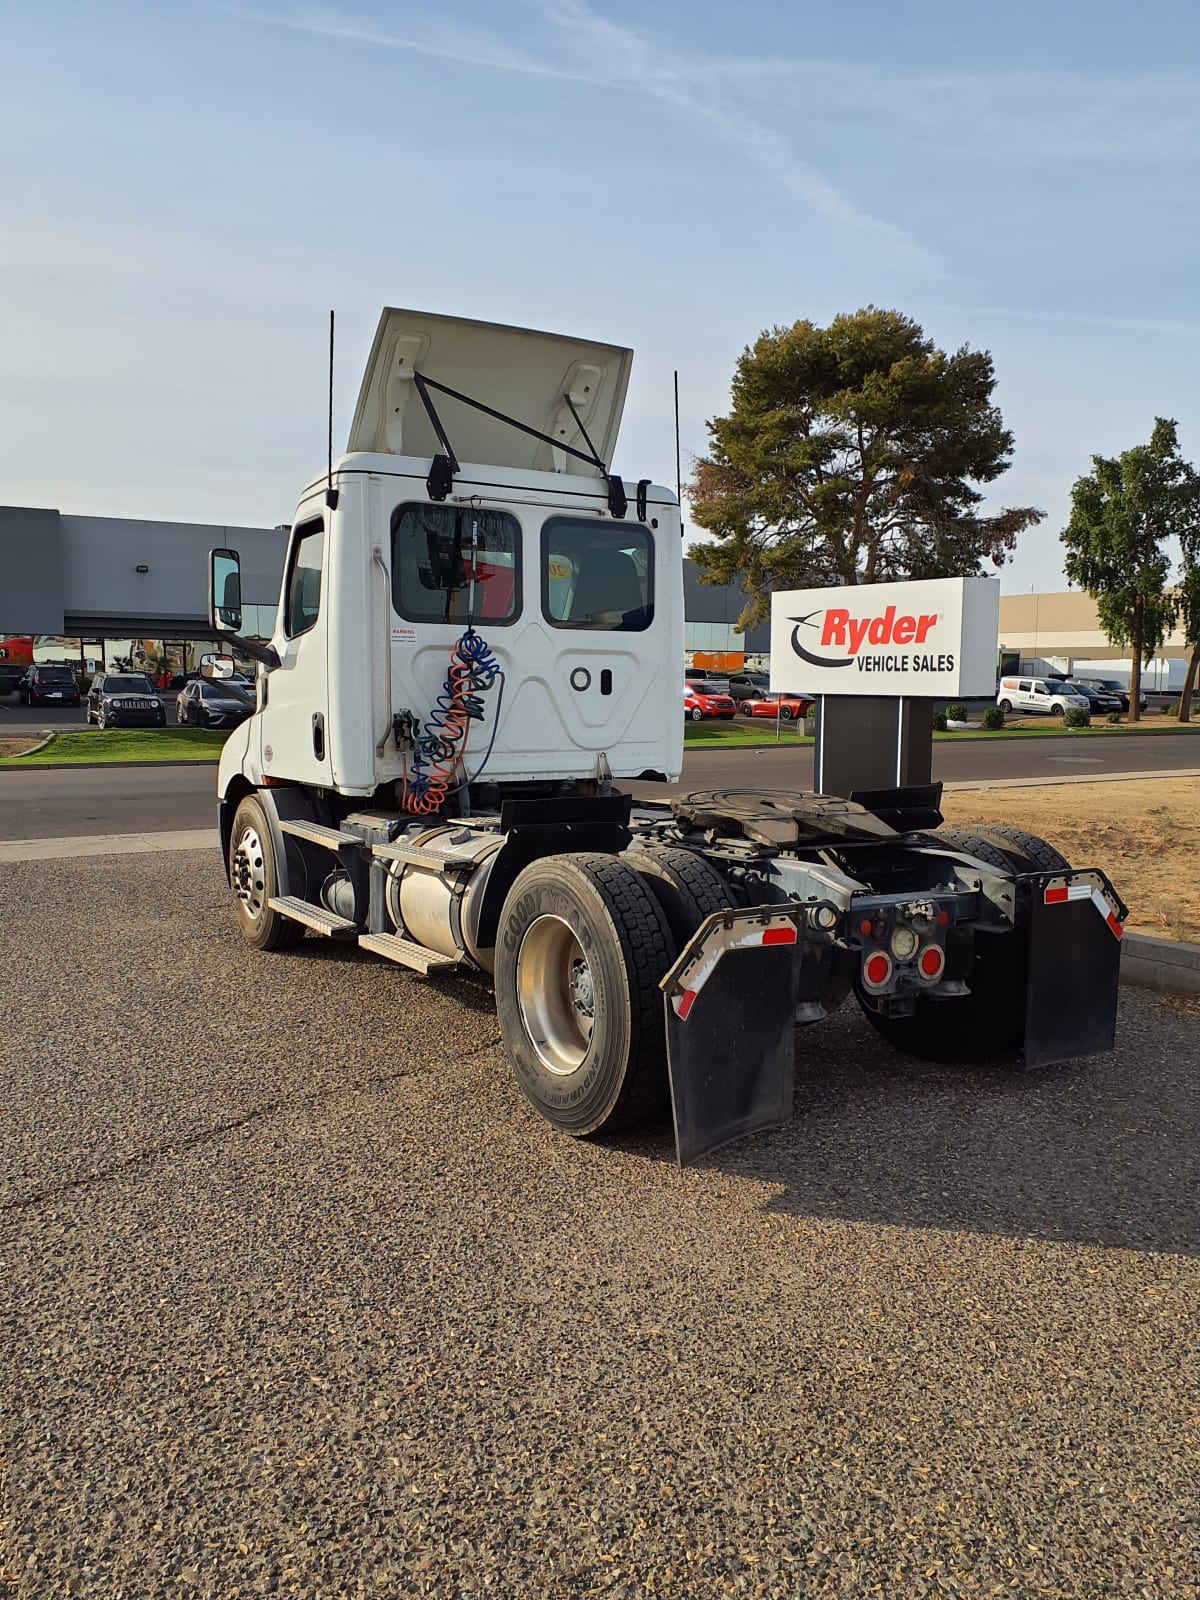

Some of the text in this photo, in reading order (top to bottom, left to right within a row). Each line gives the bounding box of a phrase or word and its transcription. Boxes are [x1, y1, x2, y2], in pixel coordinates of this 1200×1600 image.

[820, 605, 938, 655] Ryder
[857, 654, 955, 672] VEHICLE SALES
